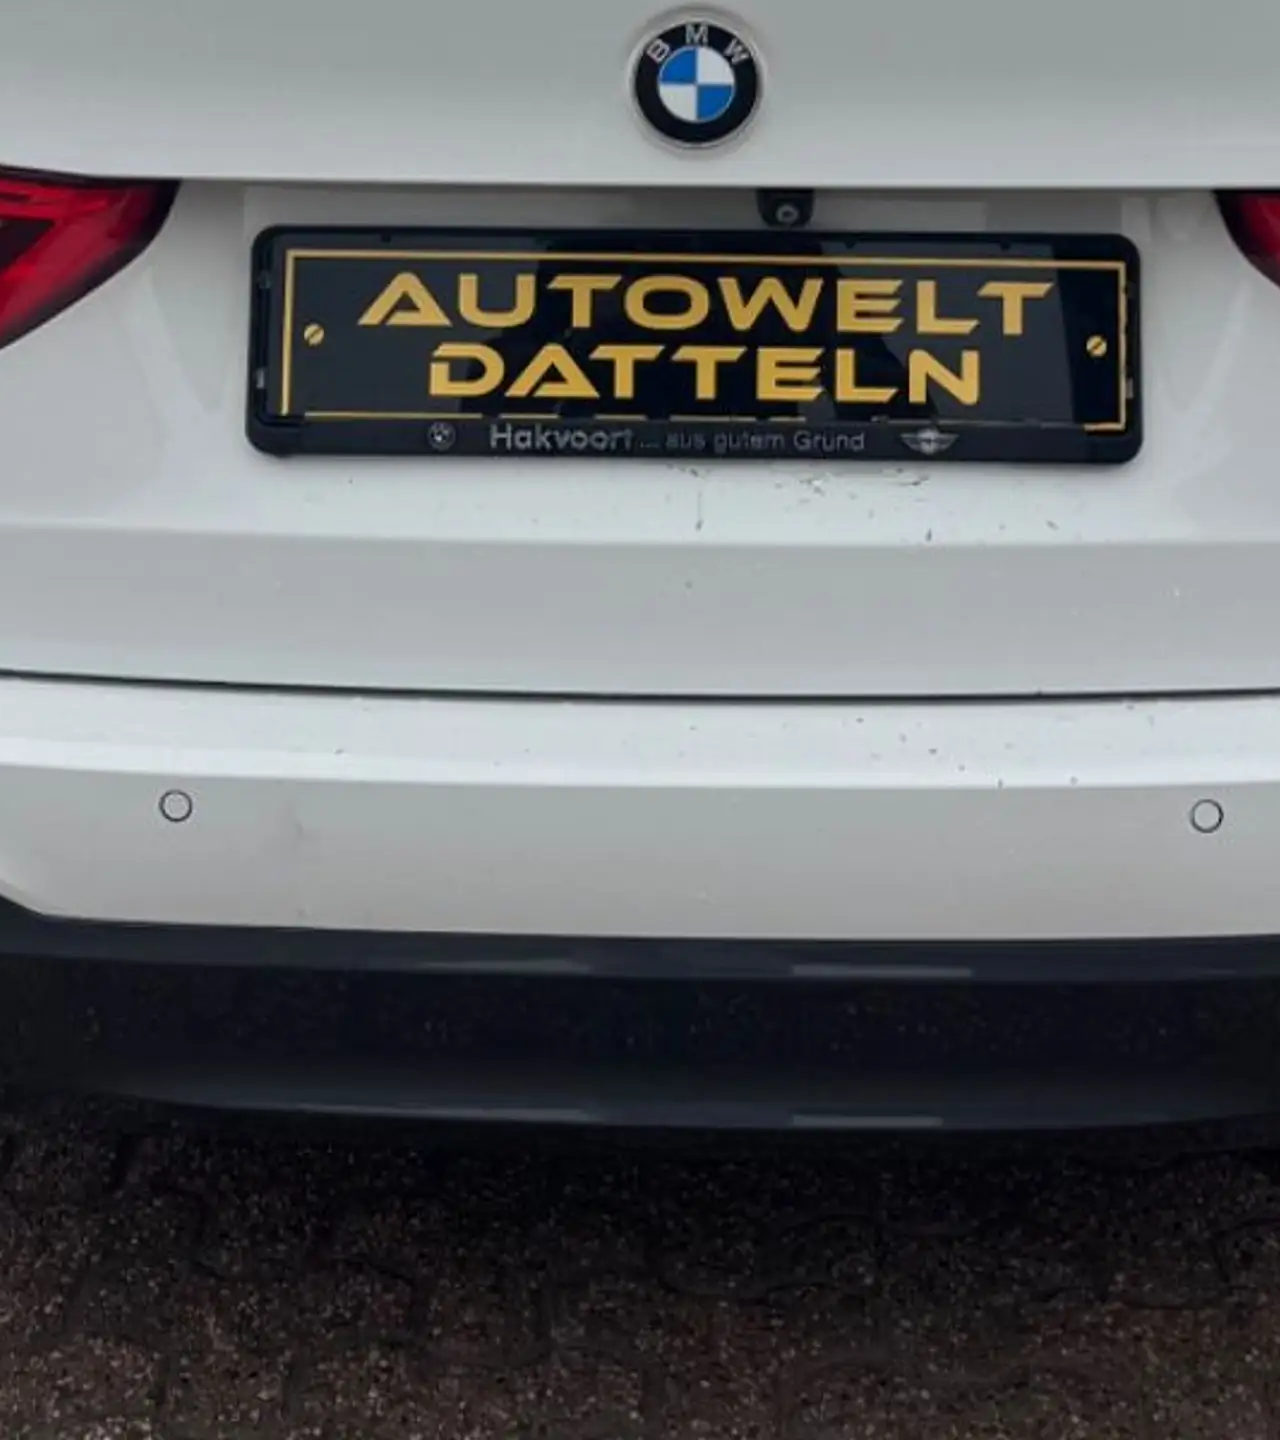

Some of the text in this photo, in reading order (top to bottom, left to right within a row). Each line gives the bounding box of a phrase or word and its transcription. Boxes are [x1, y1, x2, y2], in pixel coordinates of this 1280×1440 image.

[646, 23, 751, 65] BMW
[356, 272, 1054, 336] AUTOWELT
[428, 342, 979, 405] DATTELN
[489, 422, 634, 451] Hakvoort
[793, 429, 865, 453] Grund
